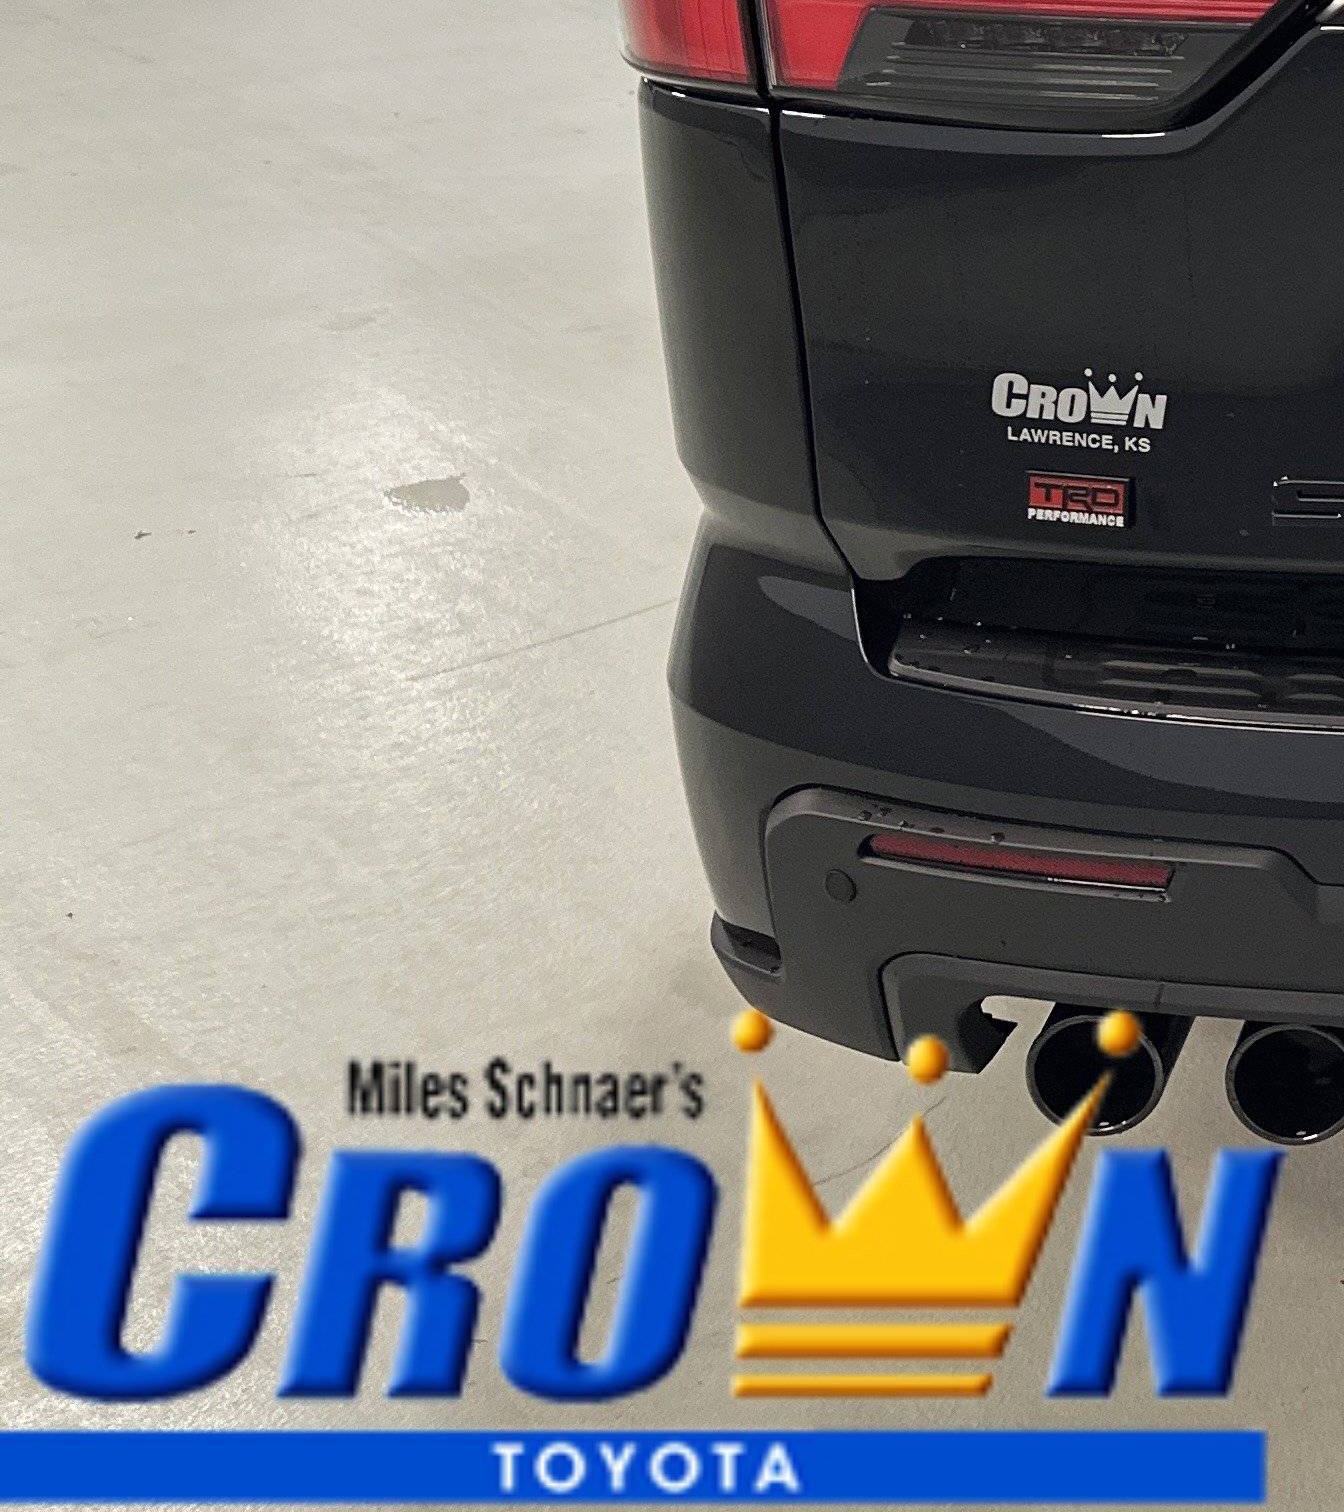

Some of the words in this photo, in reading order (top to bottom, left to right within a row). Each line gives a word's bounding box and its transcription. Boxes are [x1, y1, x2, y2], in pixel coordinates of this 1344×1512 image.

[1007, 426, 1119, 453] LAWRENCE,
[1124, 436, 1151, 453] KS
[1027, 507, 1125, 528] PERFORMANCE
